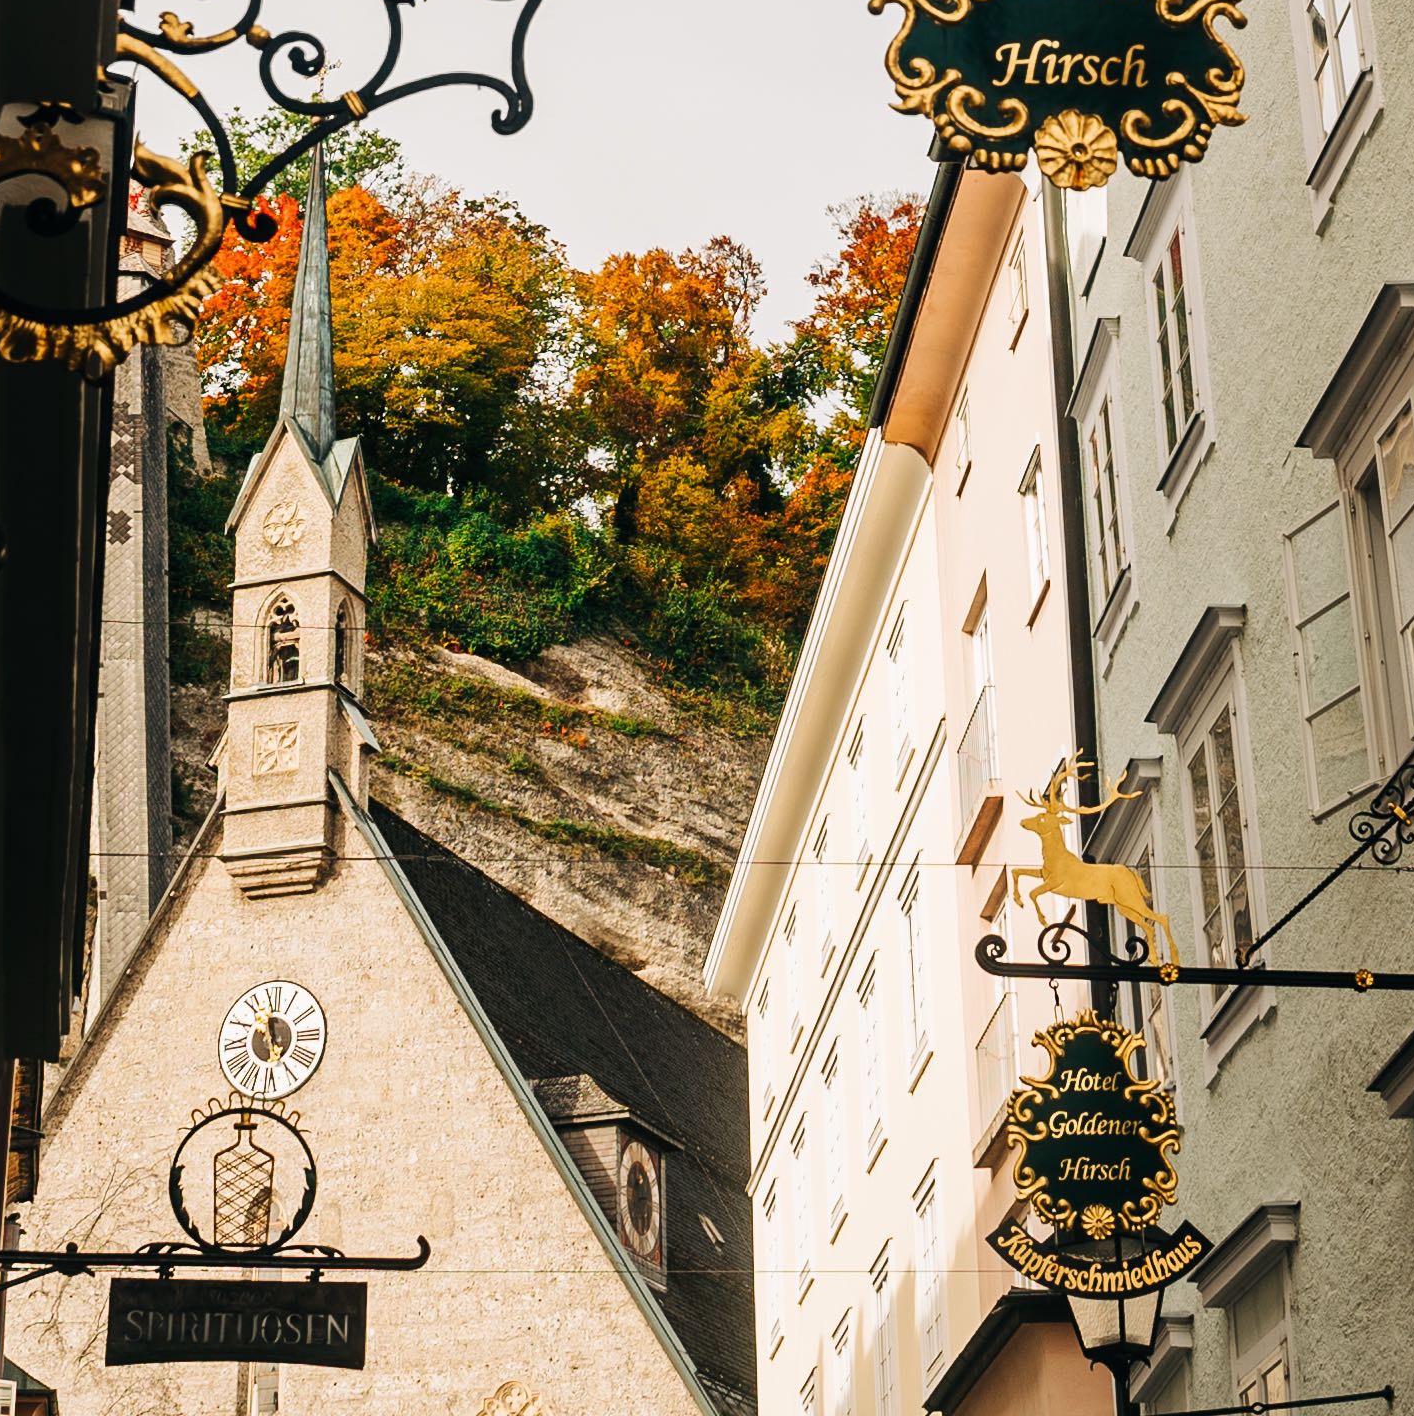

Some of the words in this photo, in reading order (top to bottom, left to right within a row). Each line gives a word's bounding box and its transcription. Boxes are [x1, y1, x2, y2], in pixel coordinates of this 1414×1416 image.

[992, 39, 1149, 88] Hirsch
[1059, 1068, 1122, 1092] Hotel
[1048, 1111, 1139, 1139] Goldener
[1058, 1157, 1131, 1182] Hirsch
[997, 1225, 1202, 1292] Kupferschmiedhaus
[123, 1308, 350, 1346] SPIRITUOSEN
